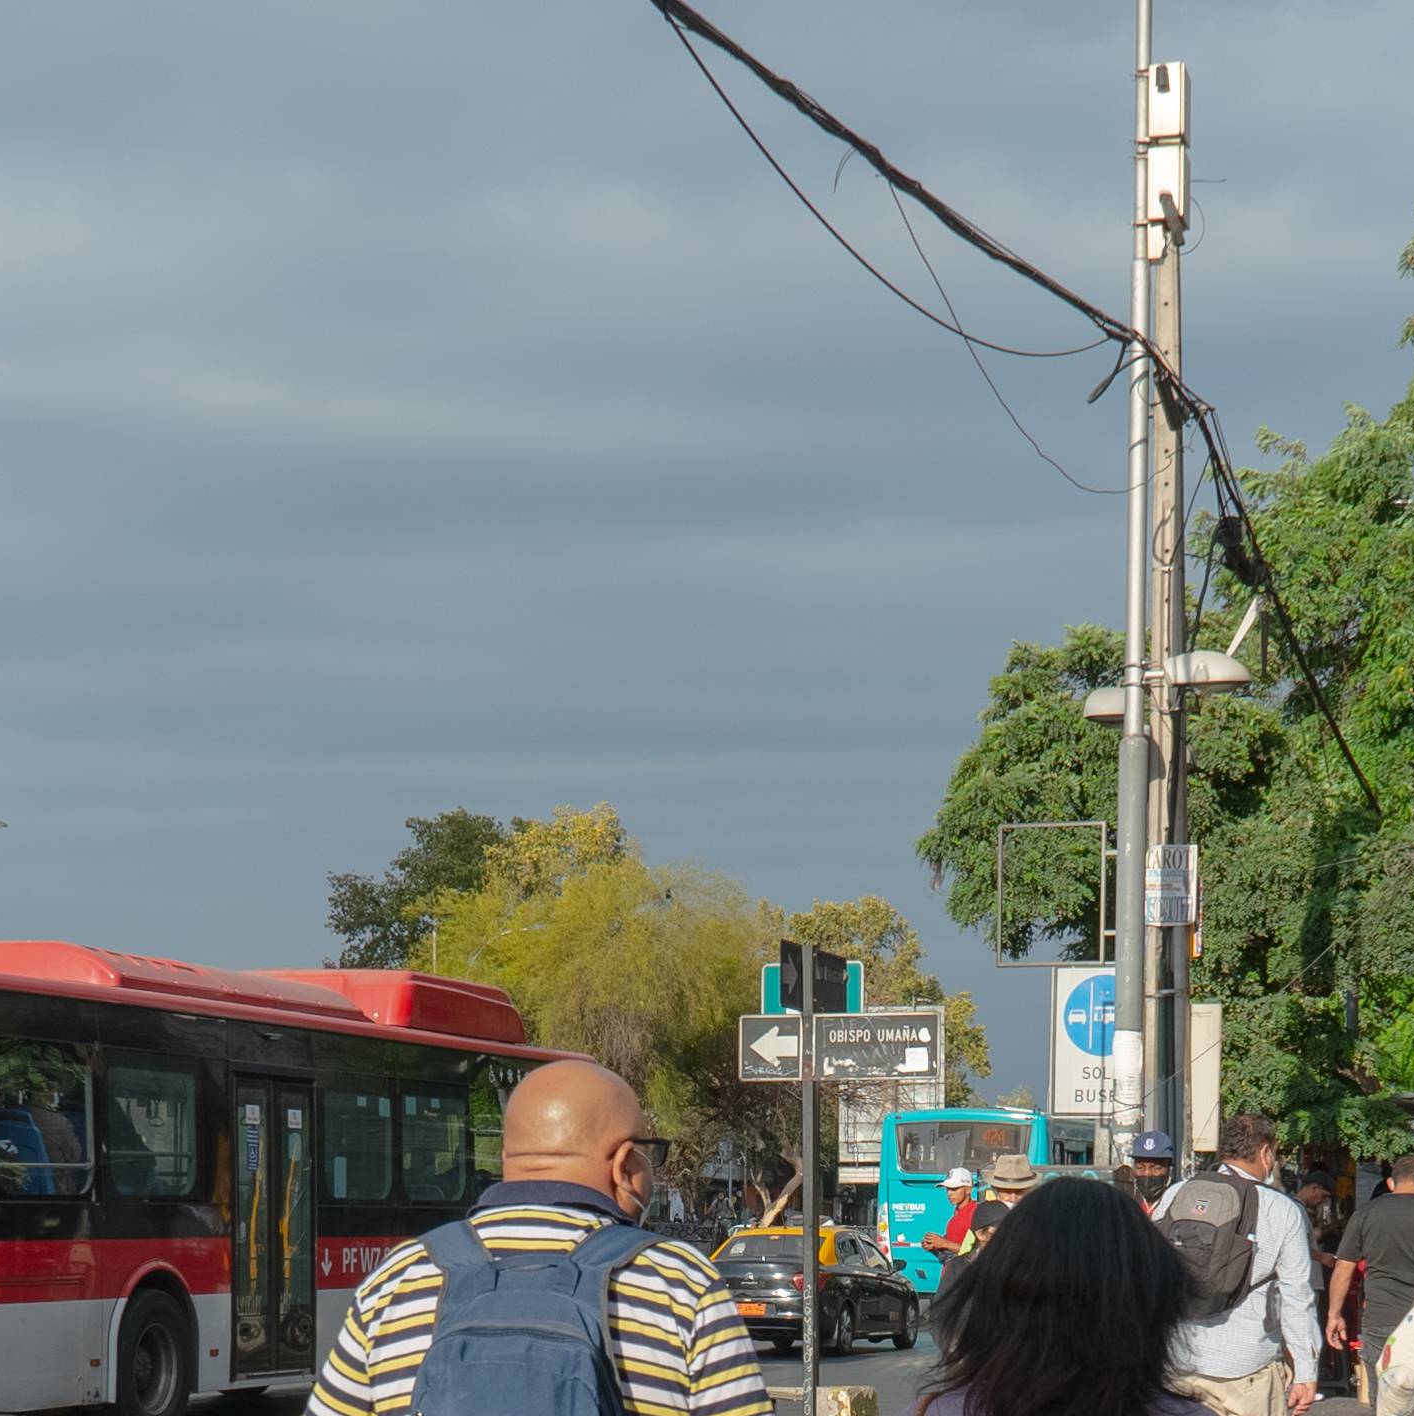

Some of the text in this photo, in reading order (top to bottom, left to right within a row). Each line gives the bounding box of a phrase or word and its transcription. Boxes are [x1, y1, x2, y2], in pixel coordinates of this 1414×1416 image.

[1146, 848, 1192, 869] TAROT
[829, 1025, 918, 1043] OBISPO UMAÑA
[1082, 1066, 1114, 1080] SOL
[1074, 1089, 1116, 1103] BUSE
[342, 1247, 358, 1273] PF
